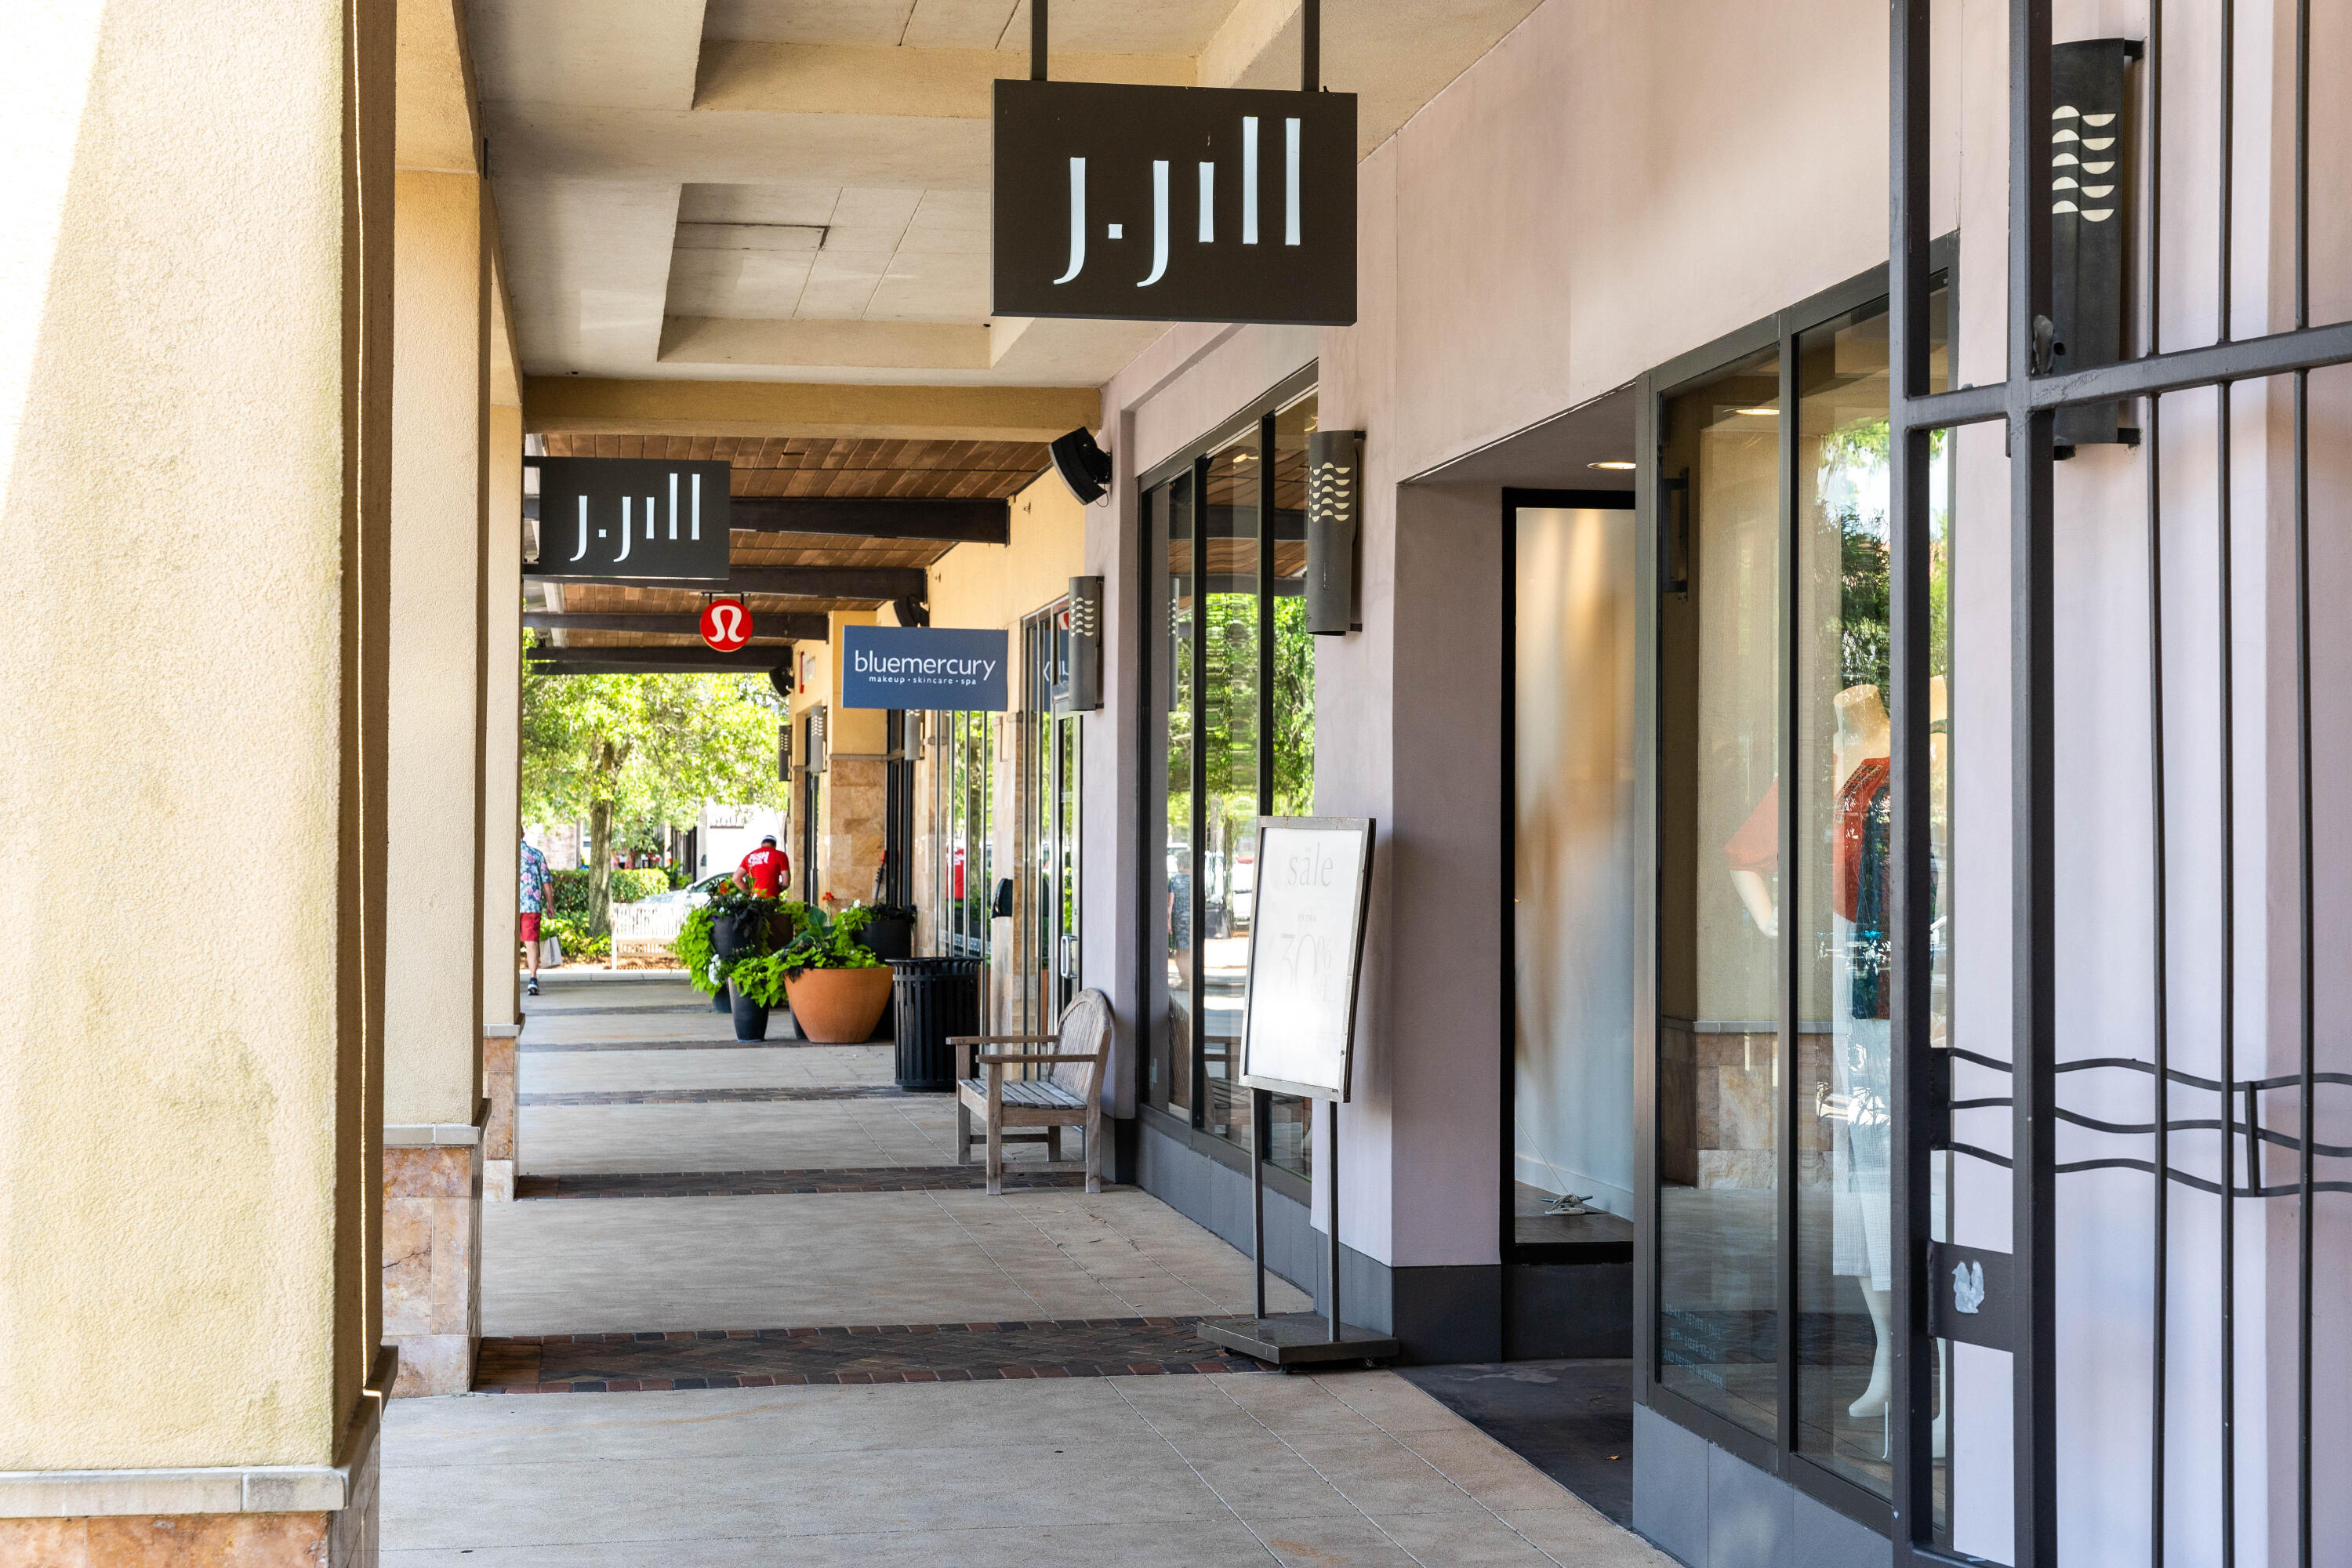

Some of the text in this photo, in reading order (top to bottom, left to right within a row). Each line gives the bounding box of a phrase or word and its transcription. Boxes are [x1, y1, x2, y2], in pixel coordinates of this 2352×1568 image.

[855, 650, 996, 681] bluemercury
[869, 675, 906, 684] makeup
[1287, 842, 1334, 887] sale
